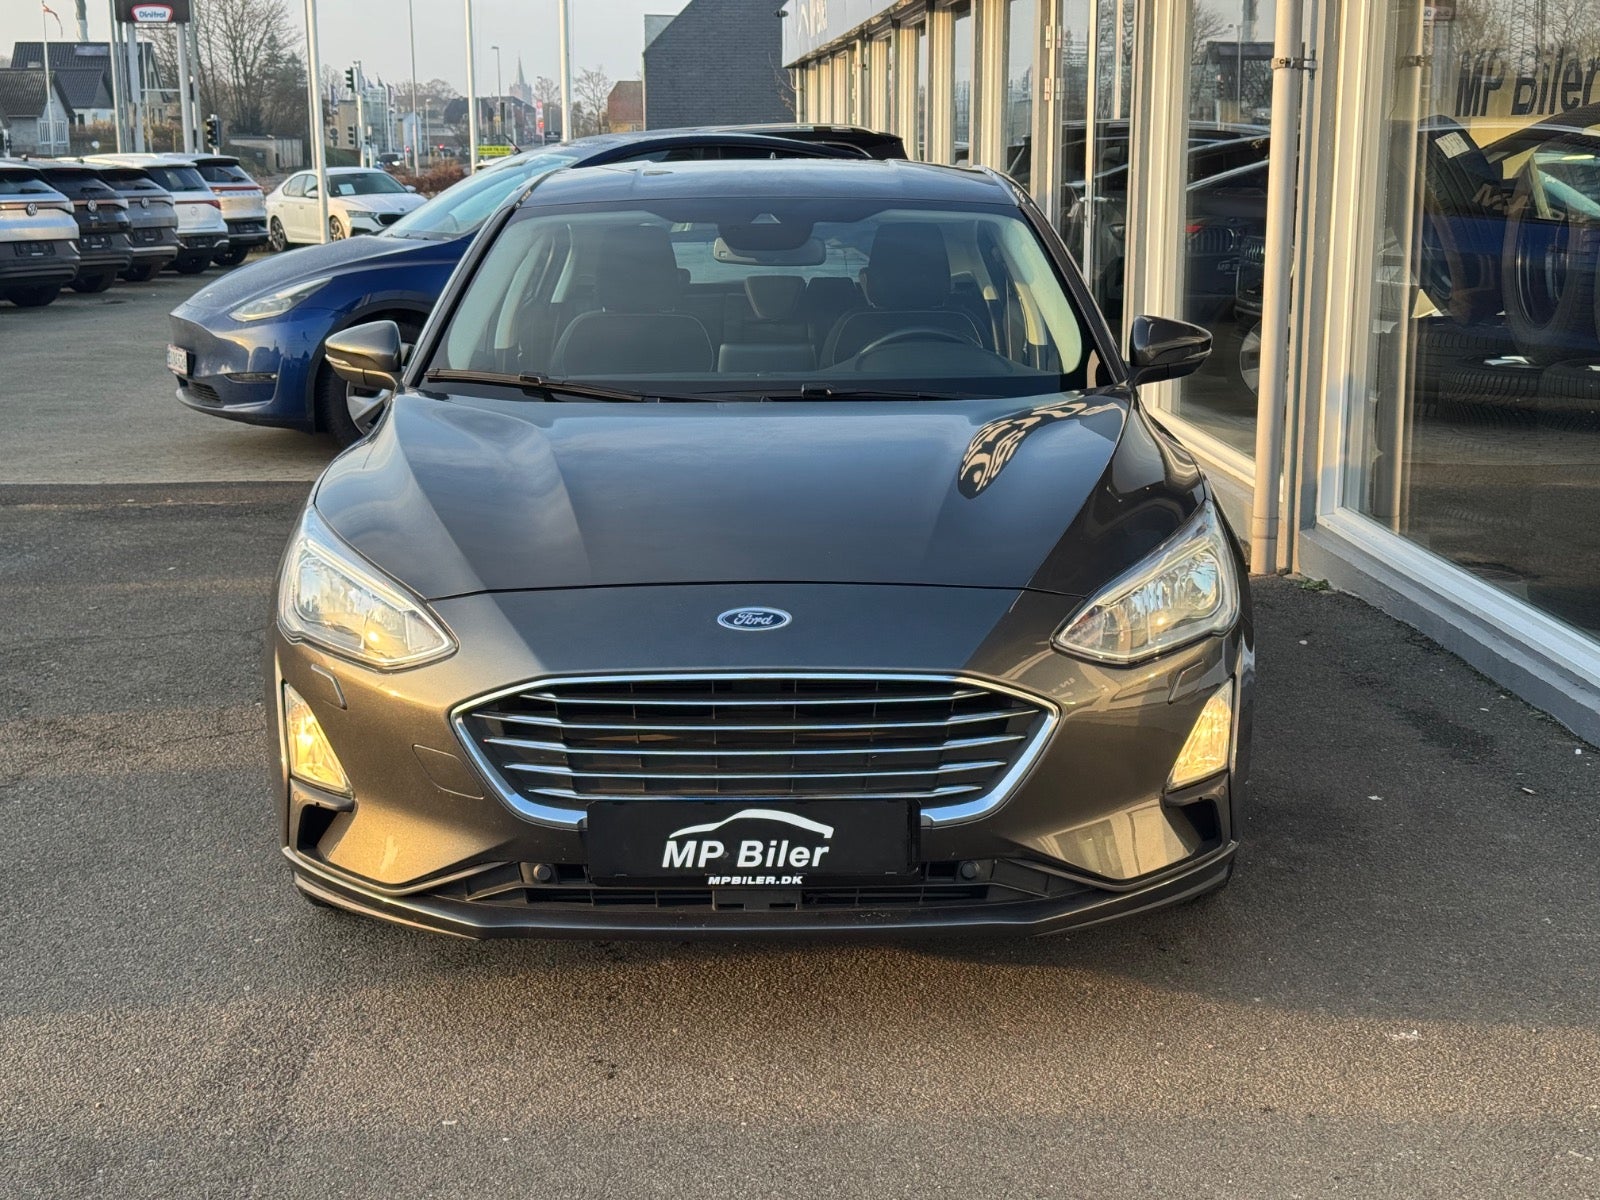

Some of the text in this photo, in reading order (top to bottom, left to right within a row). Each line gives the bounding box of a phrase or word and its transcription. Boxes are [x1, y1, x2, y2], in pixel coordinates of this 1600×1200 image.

[138, 10, 167, 18] Dinitrol
[1455, 47, 1600, 117] MP Biler
[733, 611, 775, 625] Ford
[661, 839, 830, 868] MP Biler
[707, 875, 803, 885] MPBILER.DK
